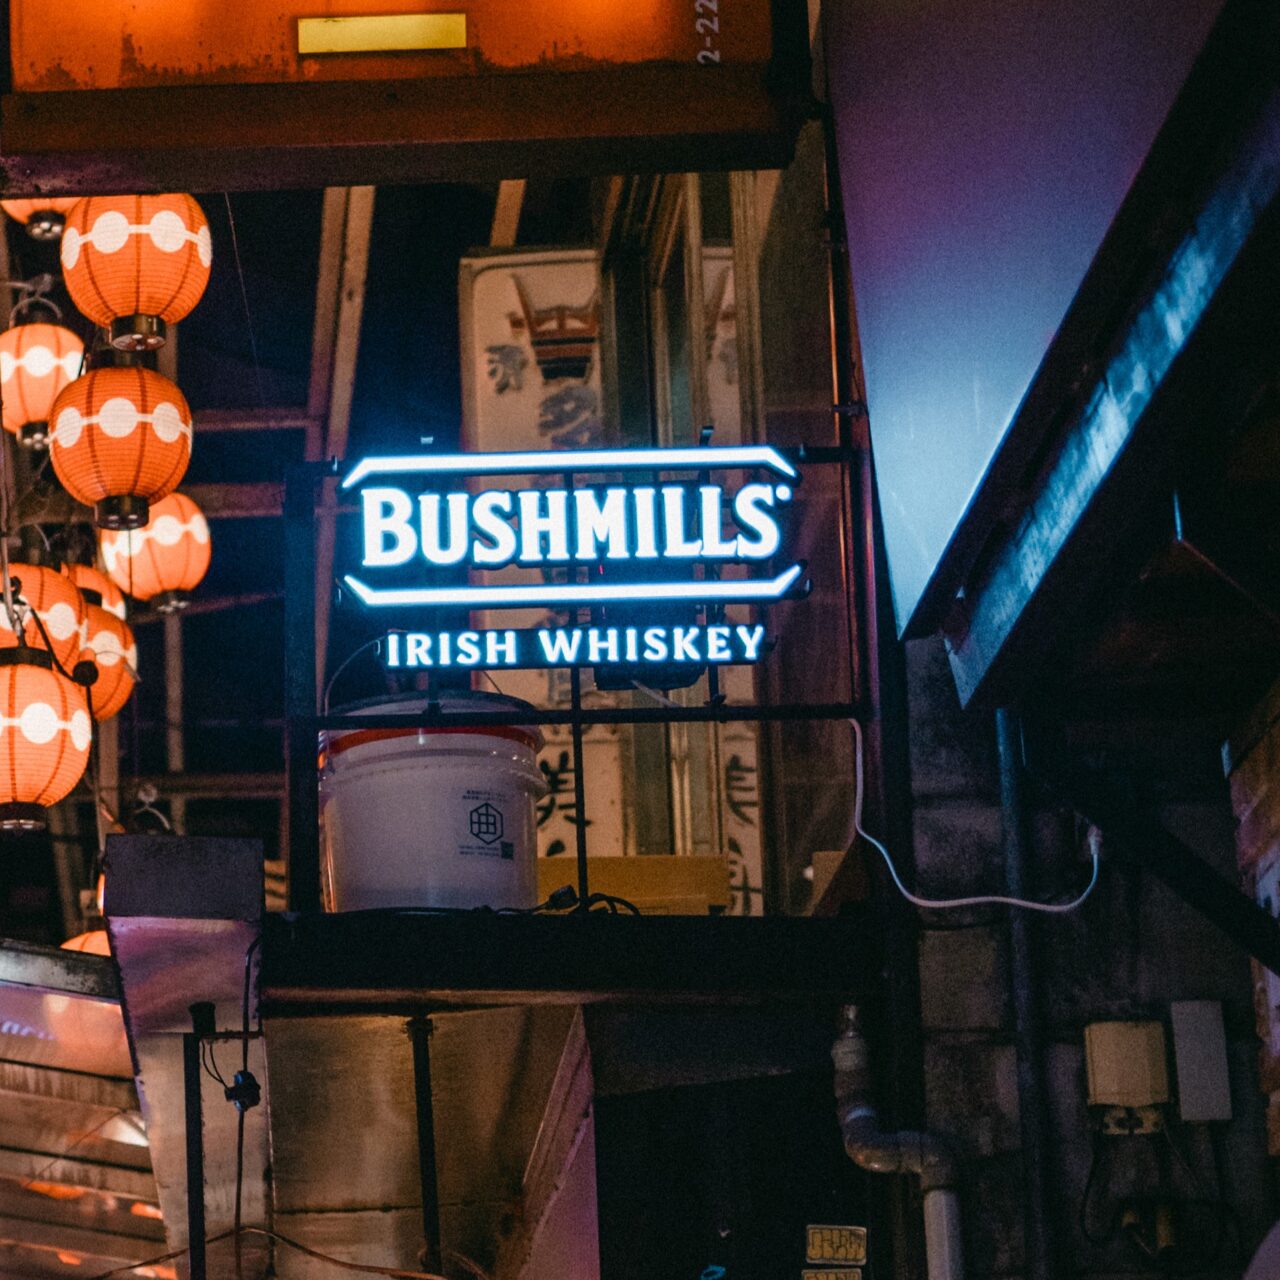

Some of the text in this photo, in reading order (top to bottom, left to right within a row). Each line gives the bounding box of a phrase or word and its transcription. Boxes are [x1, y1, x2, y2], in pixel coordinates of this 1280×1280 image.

[361, 484, 781, 567] BUSHMILLS
[387, 625, 764, 667] IRISH WHISKEY
